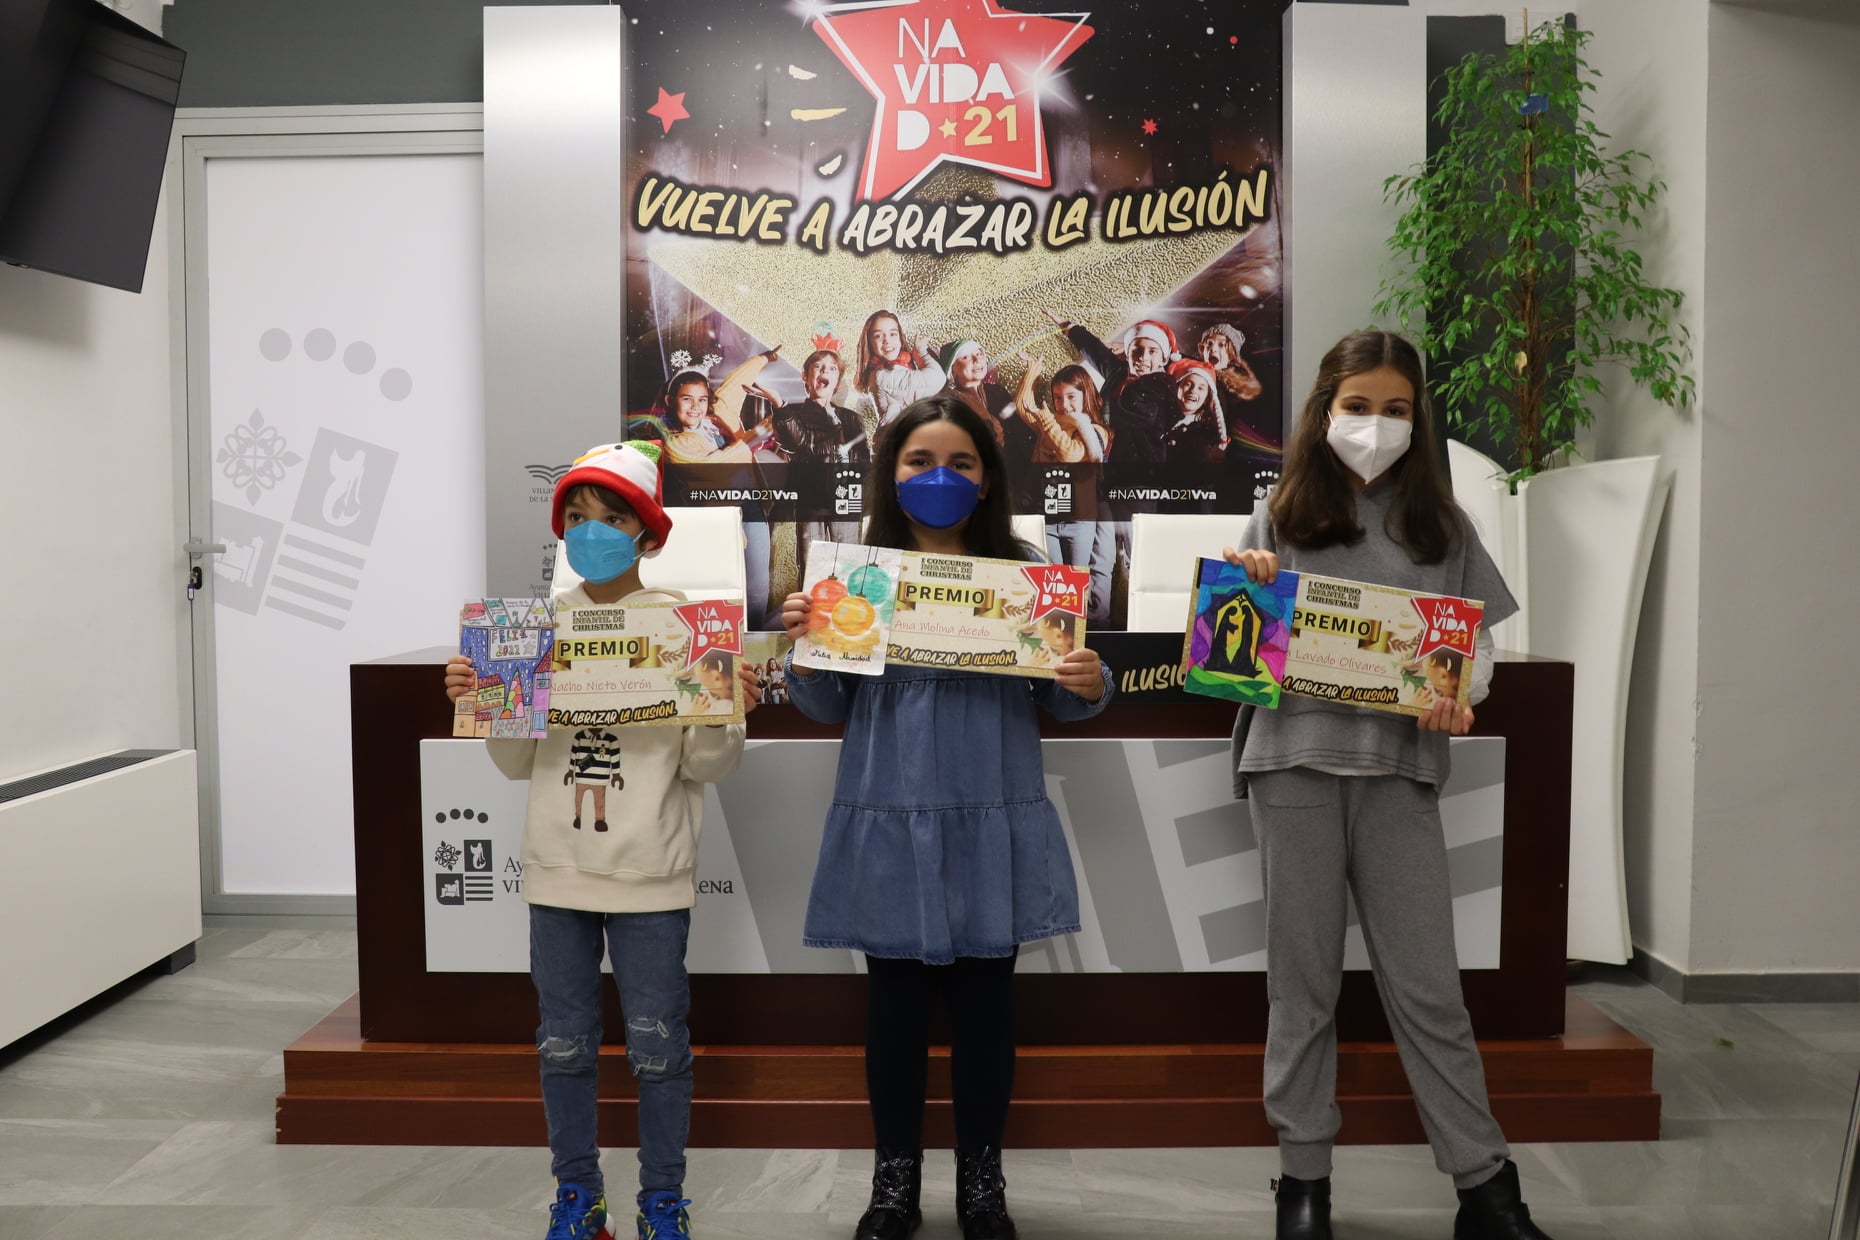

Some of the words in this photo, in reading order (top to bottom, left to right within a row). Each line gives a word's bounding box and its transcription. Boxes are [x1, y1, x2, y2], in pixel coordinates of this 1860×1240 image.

[898, 18, 967, 62] NA
[893, 63, 1015, 104] VIDA
[897, 110, 930, 150] D
[963, 104, 1017, 146] 21
[638, 178, 793, 240] VUELVE
[802, 202, 830, 249] A
[843, 203, 1033, 253] ABRAZAR
[1047, 197, 1089, 246] LA
[1106, 170, 1268, 238] ILUSIÓN
[689, 489, 799, 501] #NAVIDAD21Vva
[1107, 489, 1217, 500] #NAVIDAD21Vva
[920, 564, 959, 573] INFANTIL
[960, 566, 973, 574] DE
[926, 558, 973, 568] CONCURSO
[919, 570, 972, 581] CHRISTMAS
[1044, 569, 1064, 582] NA
[905, 585, 985, 604] PREMIO
[1042, 581, 1077, 595] VIDA
[1307, 587, 1347, 600] INFANTIL
[1348, 594, 1361, 602] DE
[1313, 581, 1362, 594] CONCURSO
[1061, 595, 1078, 607] 21
[1306, 594, 1359, 610] CHRISTMAS
[577, 609, 625, 618] CONCURSO
[697, 607, 719, 620] NA
[1434, 601, 1455, 618] NA
[572, 615, 612, 624] INFANTIL
[613, 615, 625, 623] DE
[696, 619, 733, 633] VIDA
[1292, 610, 1371, 636] PREMIO
[1432, 615, 1468, 633] VIDA
[572, 622, 625, 632] CHRISTMAS
[894, 620, 916, 630] Ana
[920, 621, 955, 633] Molina
[958, 624, 990, 637] Acedo
[717, 632, 735, 645] 21
[1449, 632, 1468, 645] 21
[560, 640, 640, 657] PREMIO
[901, 647, 911, 661] A
[910, 649, 957, 665] ABRAZAR
[959, 652, 972, 666] LA
[1296, 649, 1336, 665] Lavado
[1339, 656, 1387, 674] Olivares
[550, 681, 583, 692] Nacho
[586, 680, 617, 691] Nieto
[1293, 680, 1340, 699] ABRAZAR
[1340, 685, 1354, 699] LA
[561, 711, 570, 725] A
[571, 709, 618, 725] ABRAZAR
[620, 707, 632, 723] LA
